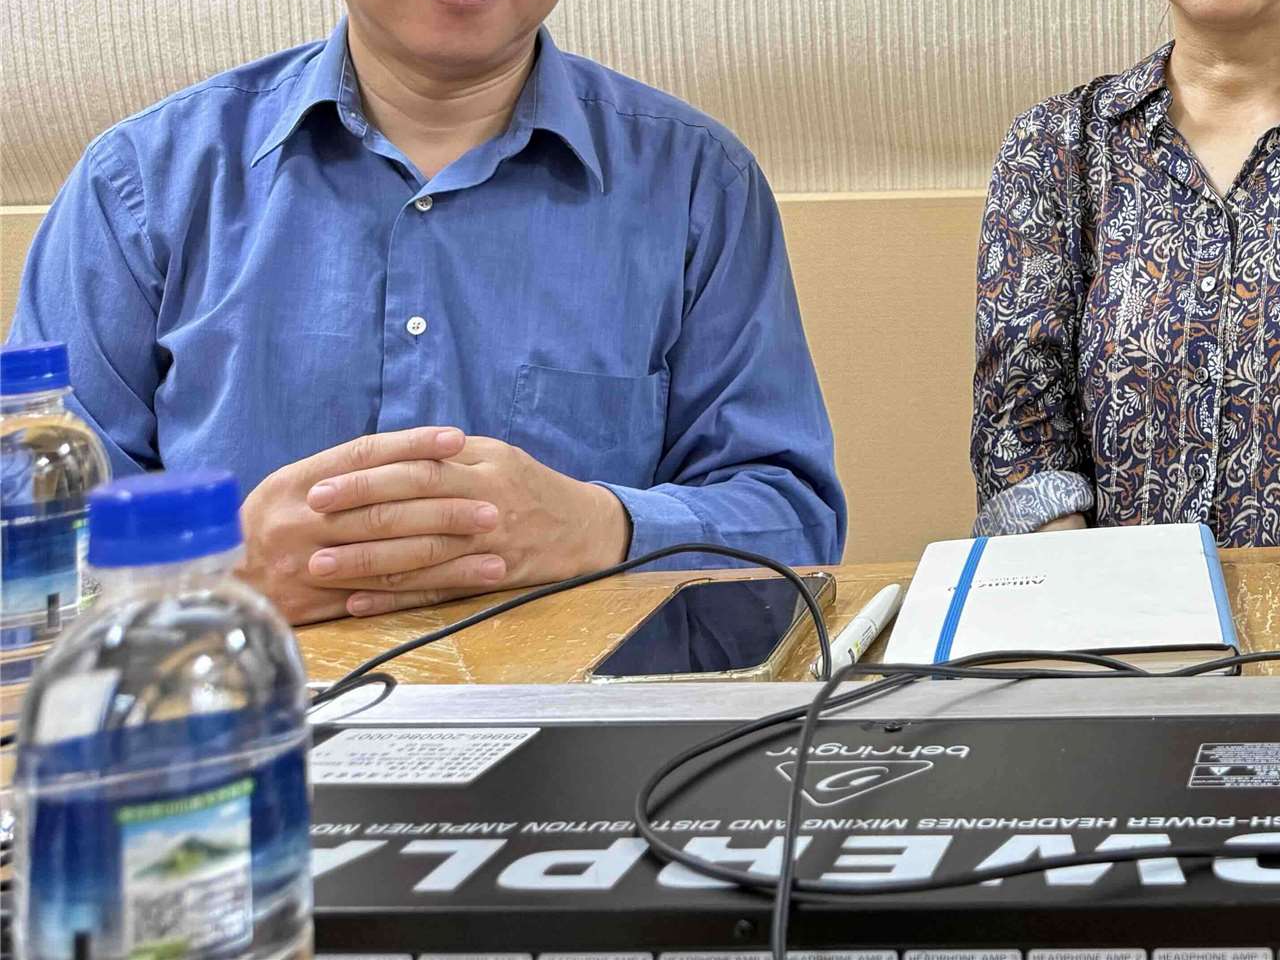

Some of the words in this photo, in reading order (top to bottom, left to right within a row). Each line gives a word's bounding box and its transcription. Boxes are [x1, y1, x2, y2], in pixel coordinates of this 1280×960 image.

[311, 822, 361, 834] MO
[364, 820, 518, 834] AMPLIFIER
[728, 818, 787, 831] AND
[800, 817, 909, 830] MIXING
[918, 817, 1118, 829] HEADPHONES
